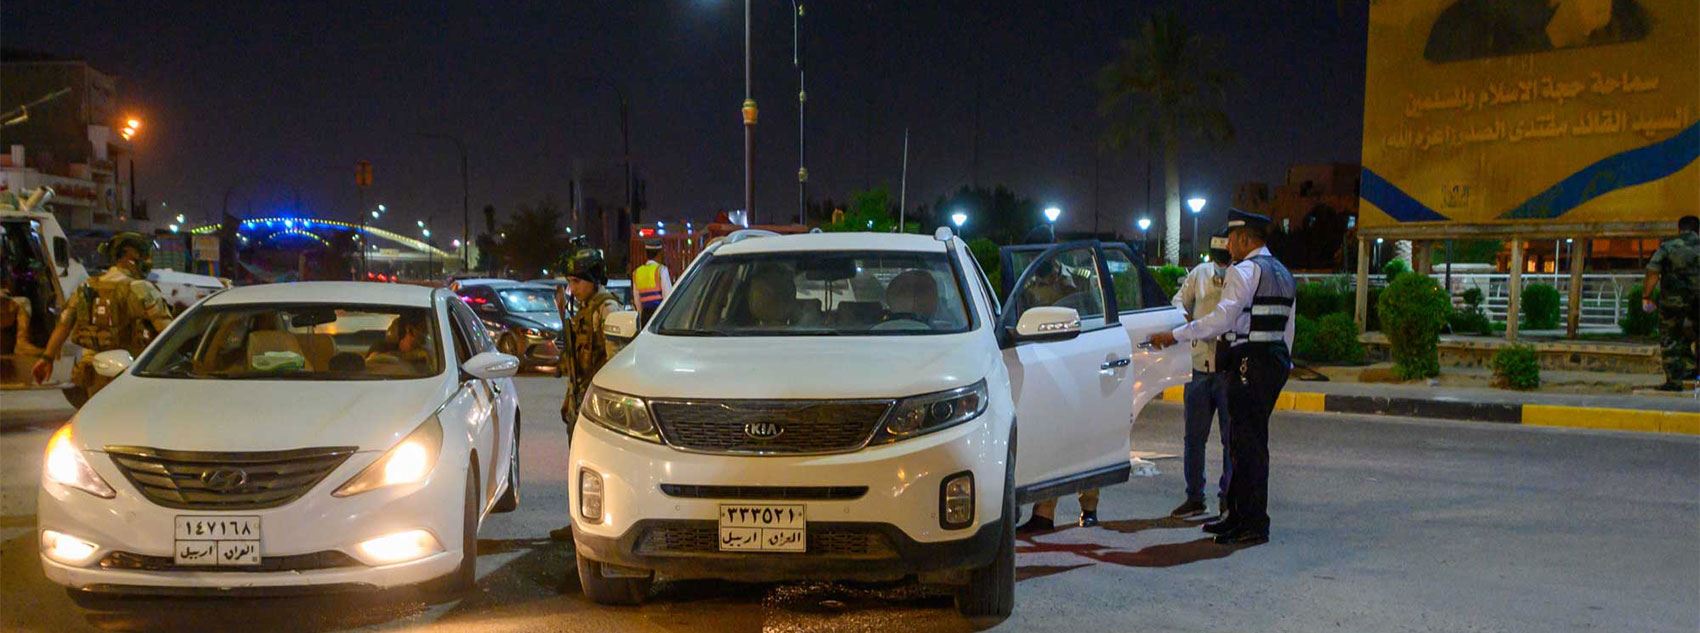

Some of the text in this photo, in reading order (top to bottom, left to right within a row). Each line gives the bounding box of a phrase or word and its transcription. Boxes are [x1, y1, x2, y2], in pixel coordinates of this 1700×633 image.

[1541, 74, 1585, 105] حجة
[1590, 70, 1660, 95] سماحة
[1632, 104, 1690, 137] السيد
[751, 423, 777, 435] KIA
[727, 507, 794, 524] ٣٣٣٥٢١
[186, 521, 251, 536] ١٤٧١٦٨
[722, 532, 757, 547] اربيل
[769, 532, 801, 547] العراق
[180, 546, 213, 560] اربيل
[224, 545, 254, 560] العراق
